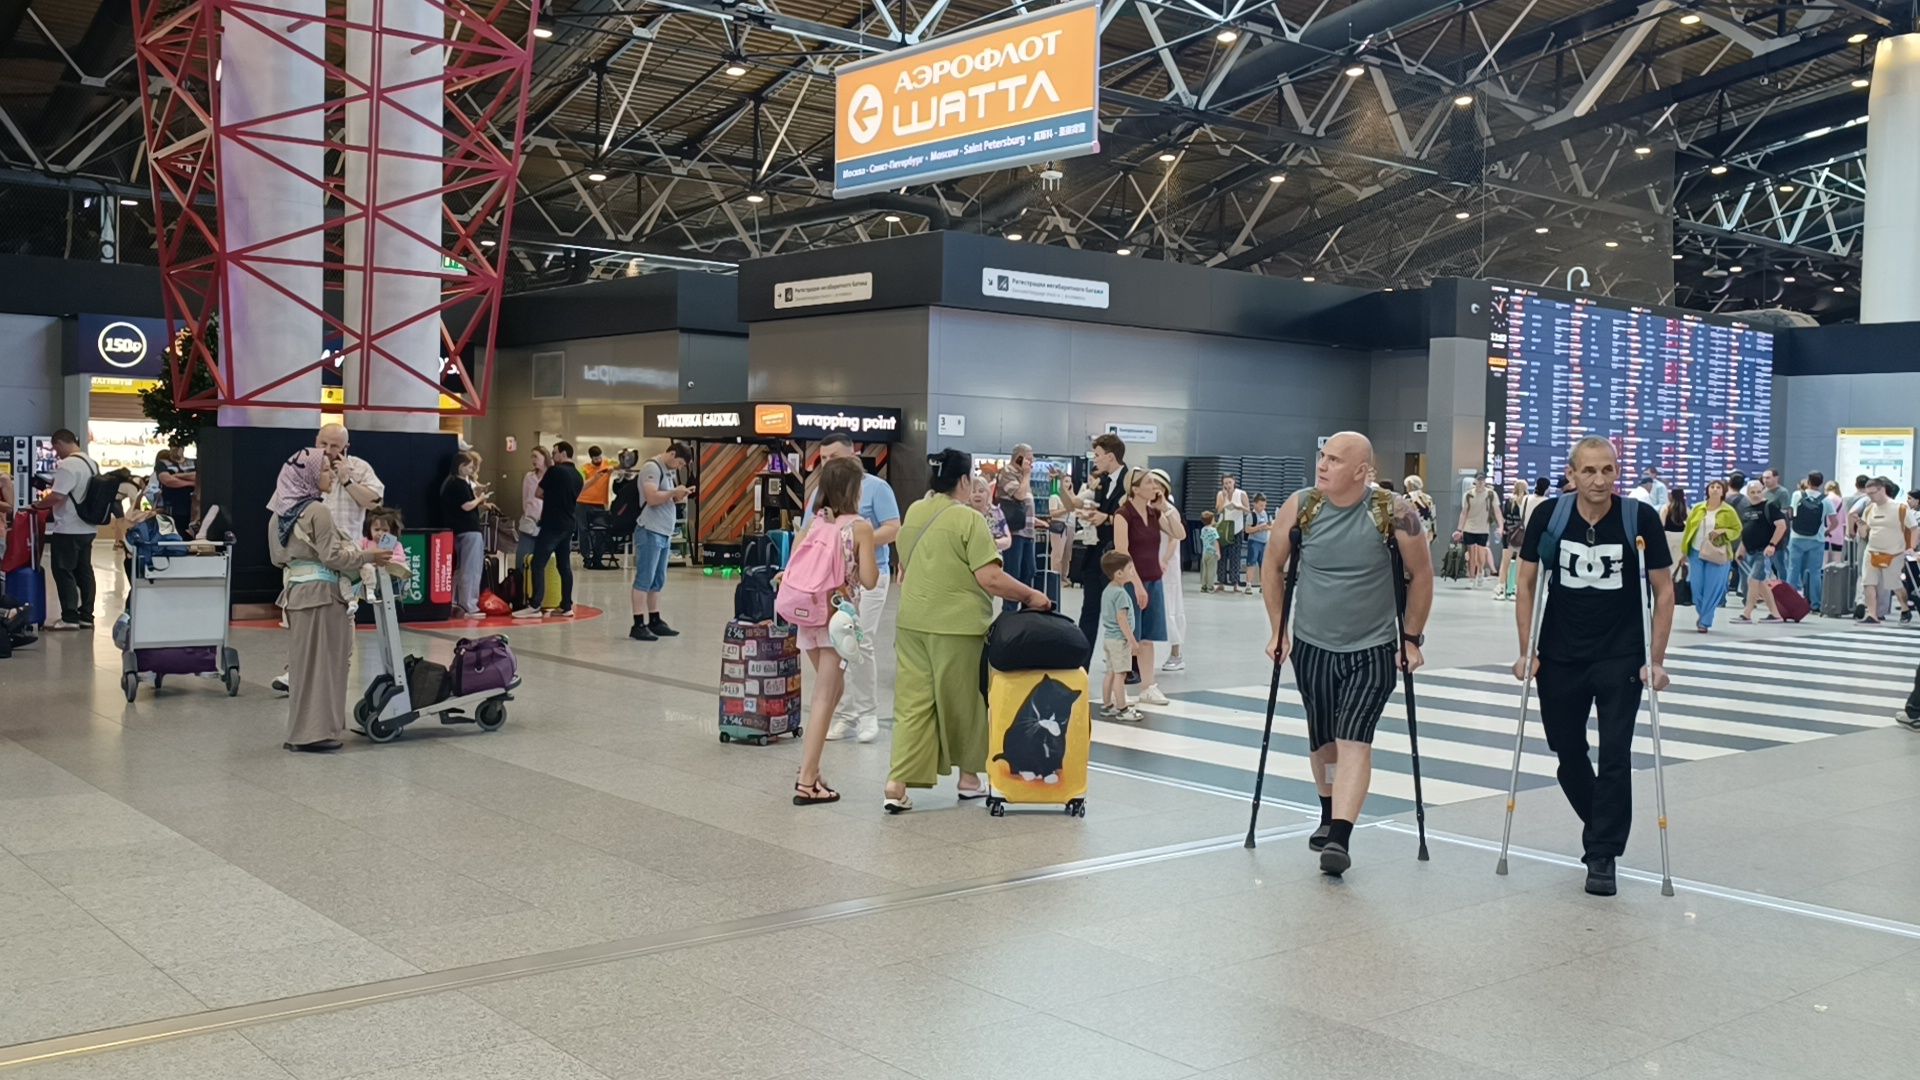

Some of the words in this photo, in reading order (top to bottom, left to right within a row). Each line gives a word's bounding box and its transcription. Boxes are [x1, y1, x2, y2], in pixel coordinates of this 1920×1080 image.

[894, 30, 1062, 94] АЭРОФЛОТ
[892, 70, 1061, 137] ШАТТЛ
[843, 168, 866, 179] Москва
[869, 156, 924, 173] Санкт-Петербург
[930, 149, 959, 161] Moscow
[963, 142, 983, 155] Saint
[984, 135, 1026, 151] Petersburg
[796, 412, 859, 432] wrapping
[863, 414, 896, 431] point
[412, 554, 421, 589] PAPER
